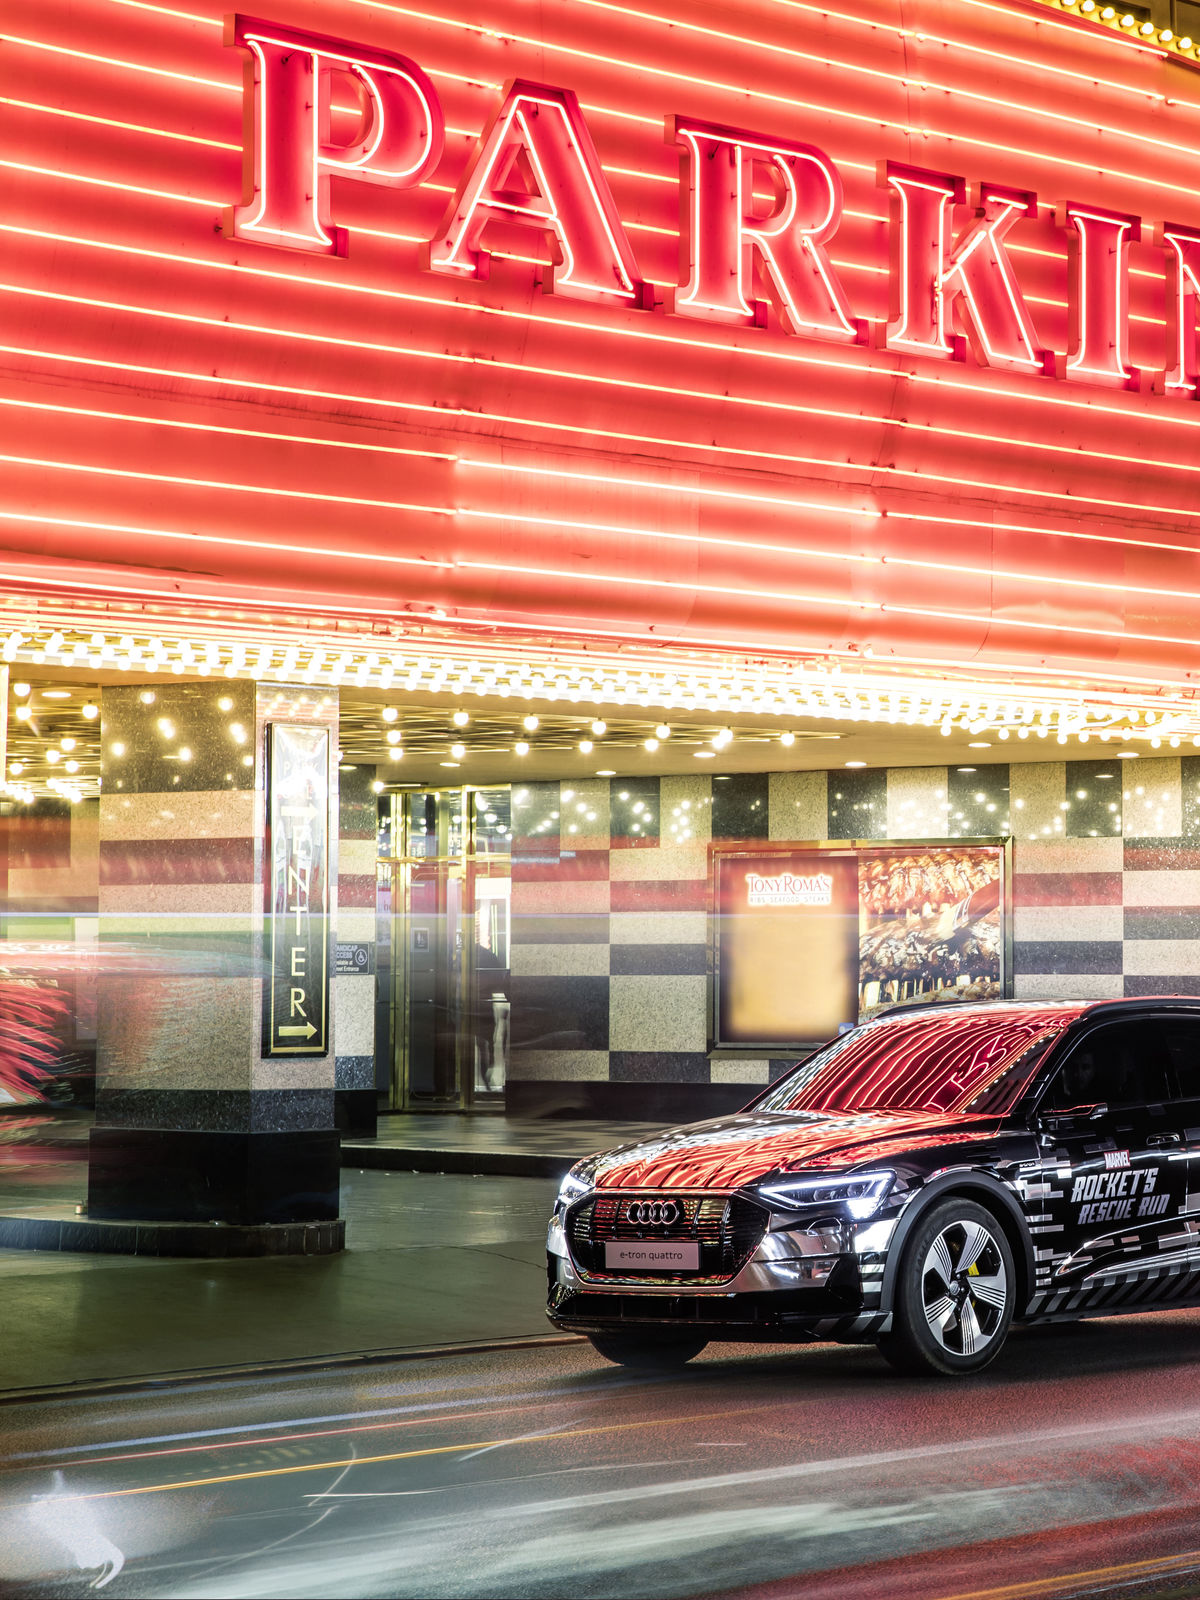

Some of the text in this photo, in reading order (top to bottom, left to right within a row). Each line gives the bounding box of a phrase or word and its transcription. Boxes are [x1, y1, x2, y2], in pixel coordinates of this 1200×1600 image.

[287, 824, 310, 1018] ENTER
[1104, 1150, 1131, 1169] MARVEL
[1070, 1167, 1160, 1203] ROCKET'S
[1077, 1193, 1171, 1225] RESCUE RUN
[620, 1250, 683, 1261] e-tron quattro
